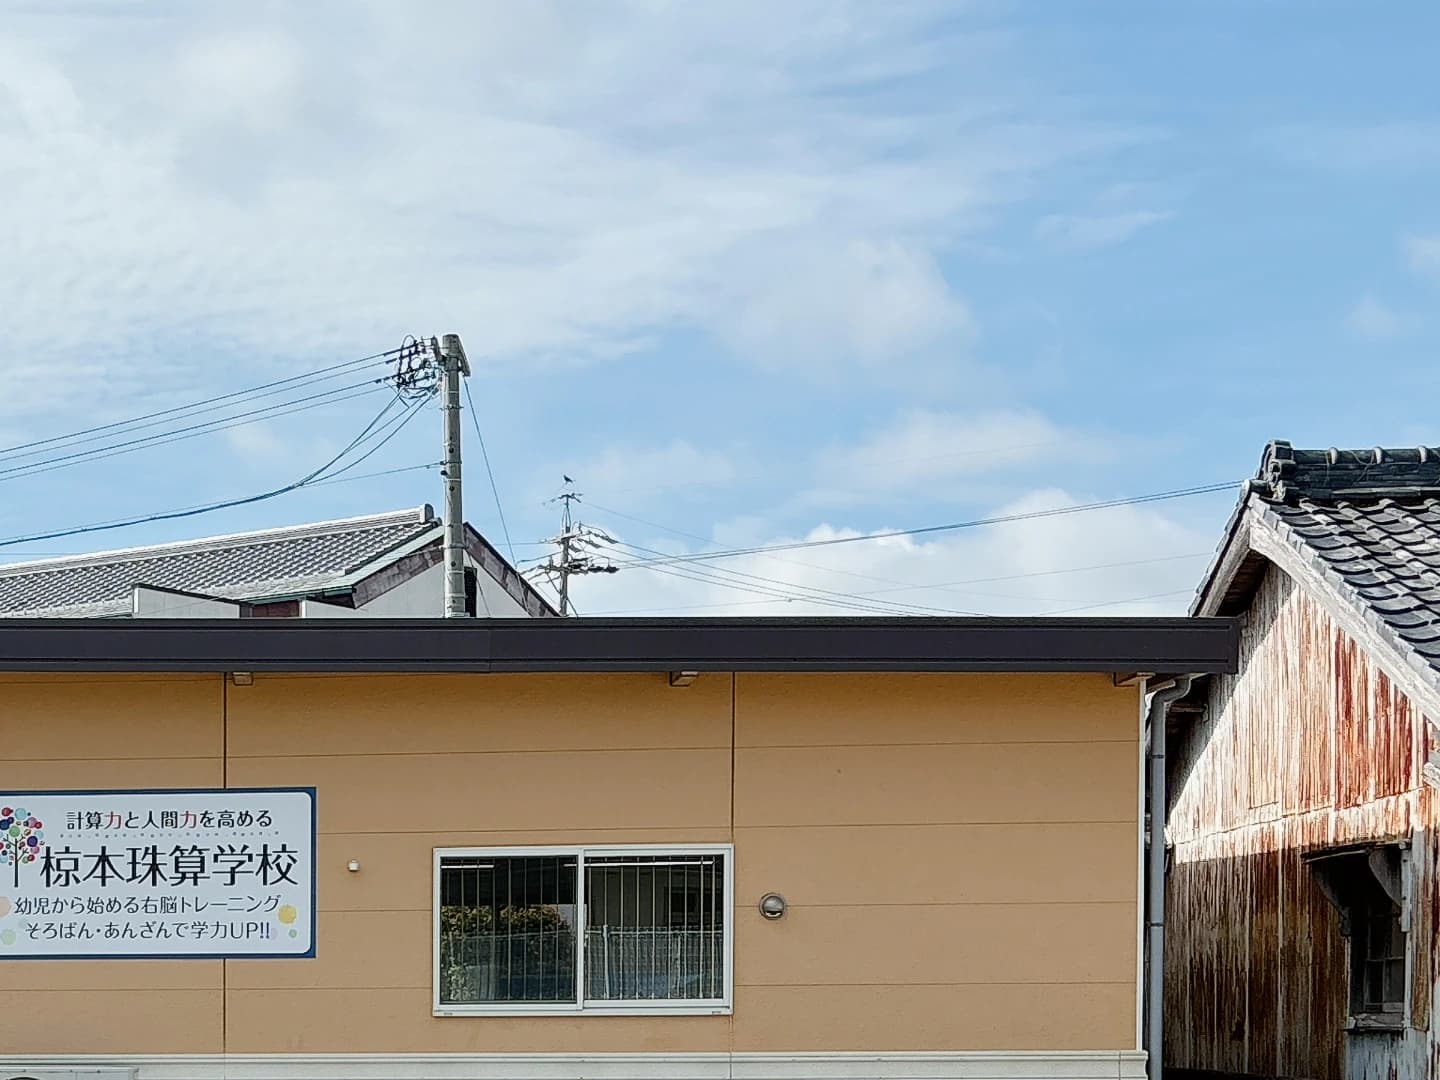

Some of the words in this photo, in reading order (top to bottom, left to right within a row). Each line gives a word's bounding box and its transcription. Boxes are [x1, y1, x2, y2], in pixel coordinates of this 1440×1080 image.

[66, 810, 272, 830] 計算力と人間力を高める
[40, 843, 298, 888] 椋本珠算学校
[14, 894, 281, 915] 幼児から始める右脳トレーニング
